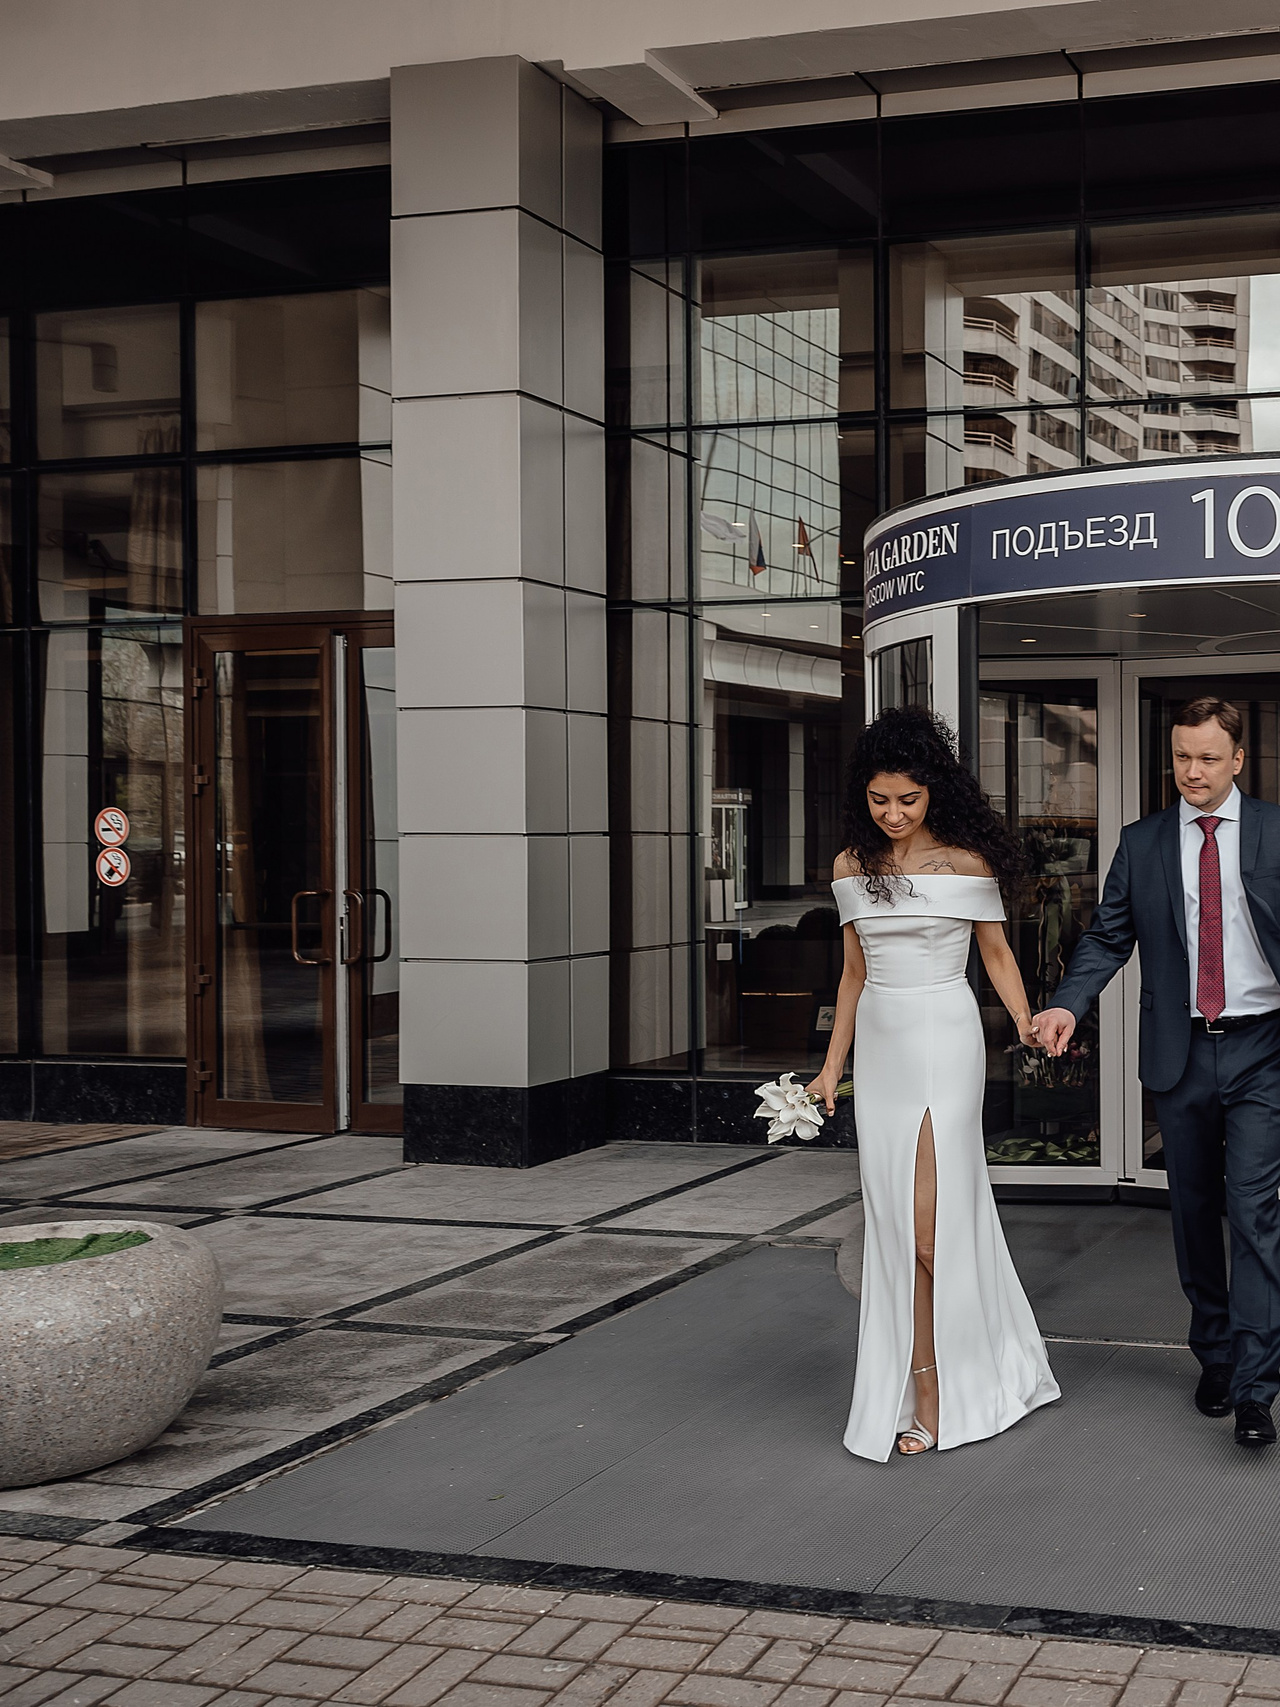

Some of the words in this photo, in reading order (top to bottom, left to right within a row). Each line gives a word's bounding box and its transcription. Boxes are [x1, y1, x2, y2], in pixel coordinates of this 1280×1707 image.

[881, 522, 960, 572] GARDEN
[991, 512, 1159, 560] ПОДЪЕЗД
[867, 578, 895, 608] OSCOW
[897, 570, 925, 597] WTC
